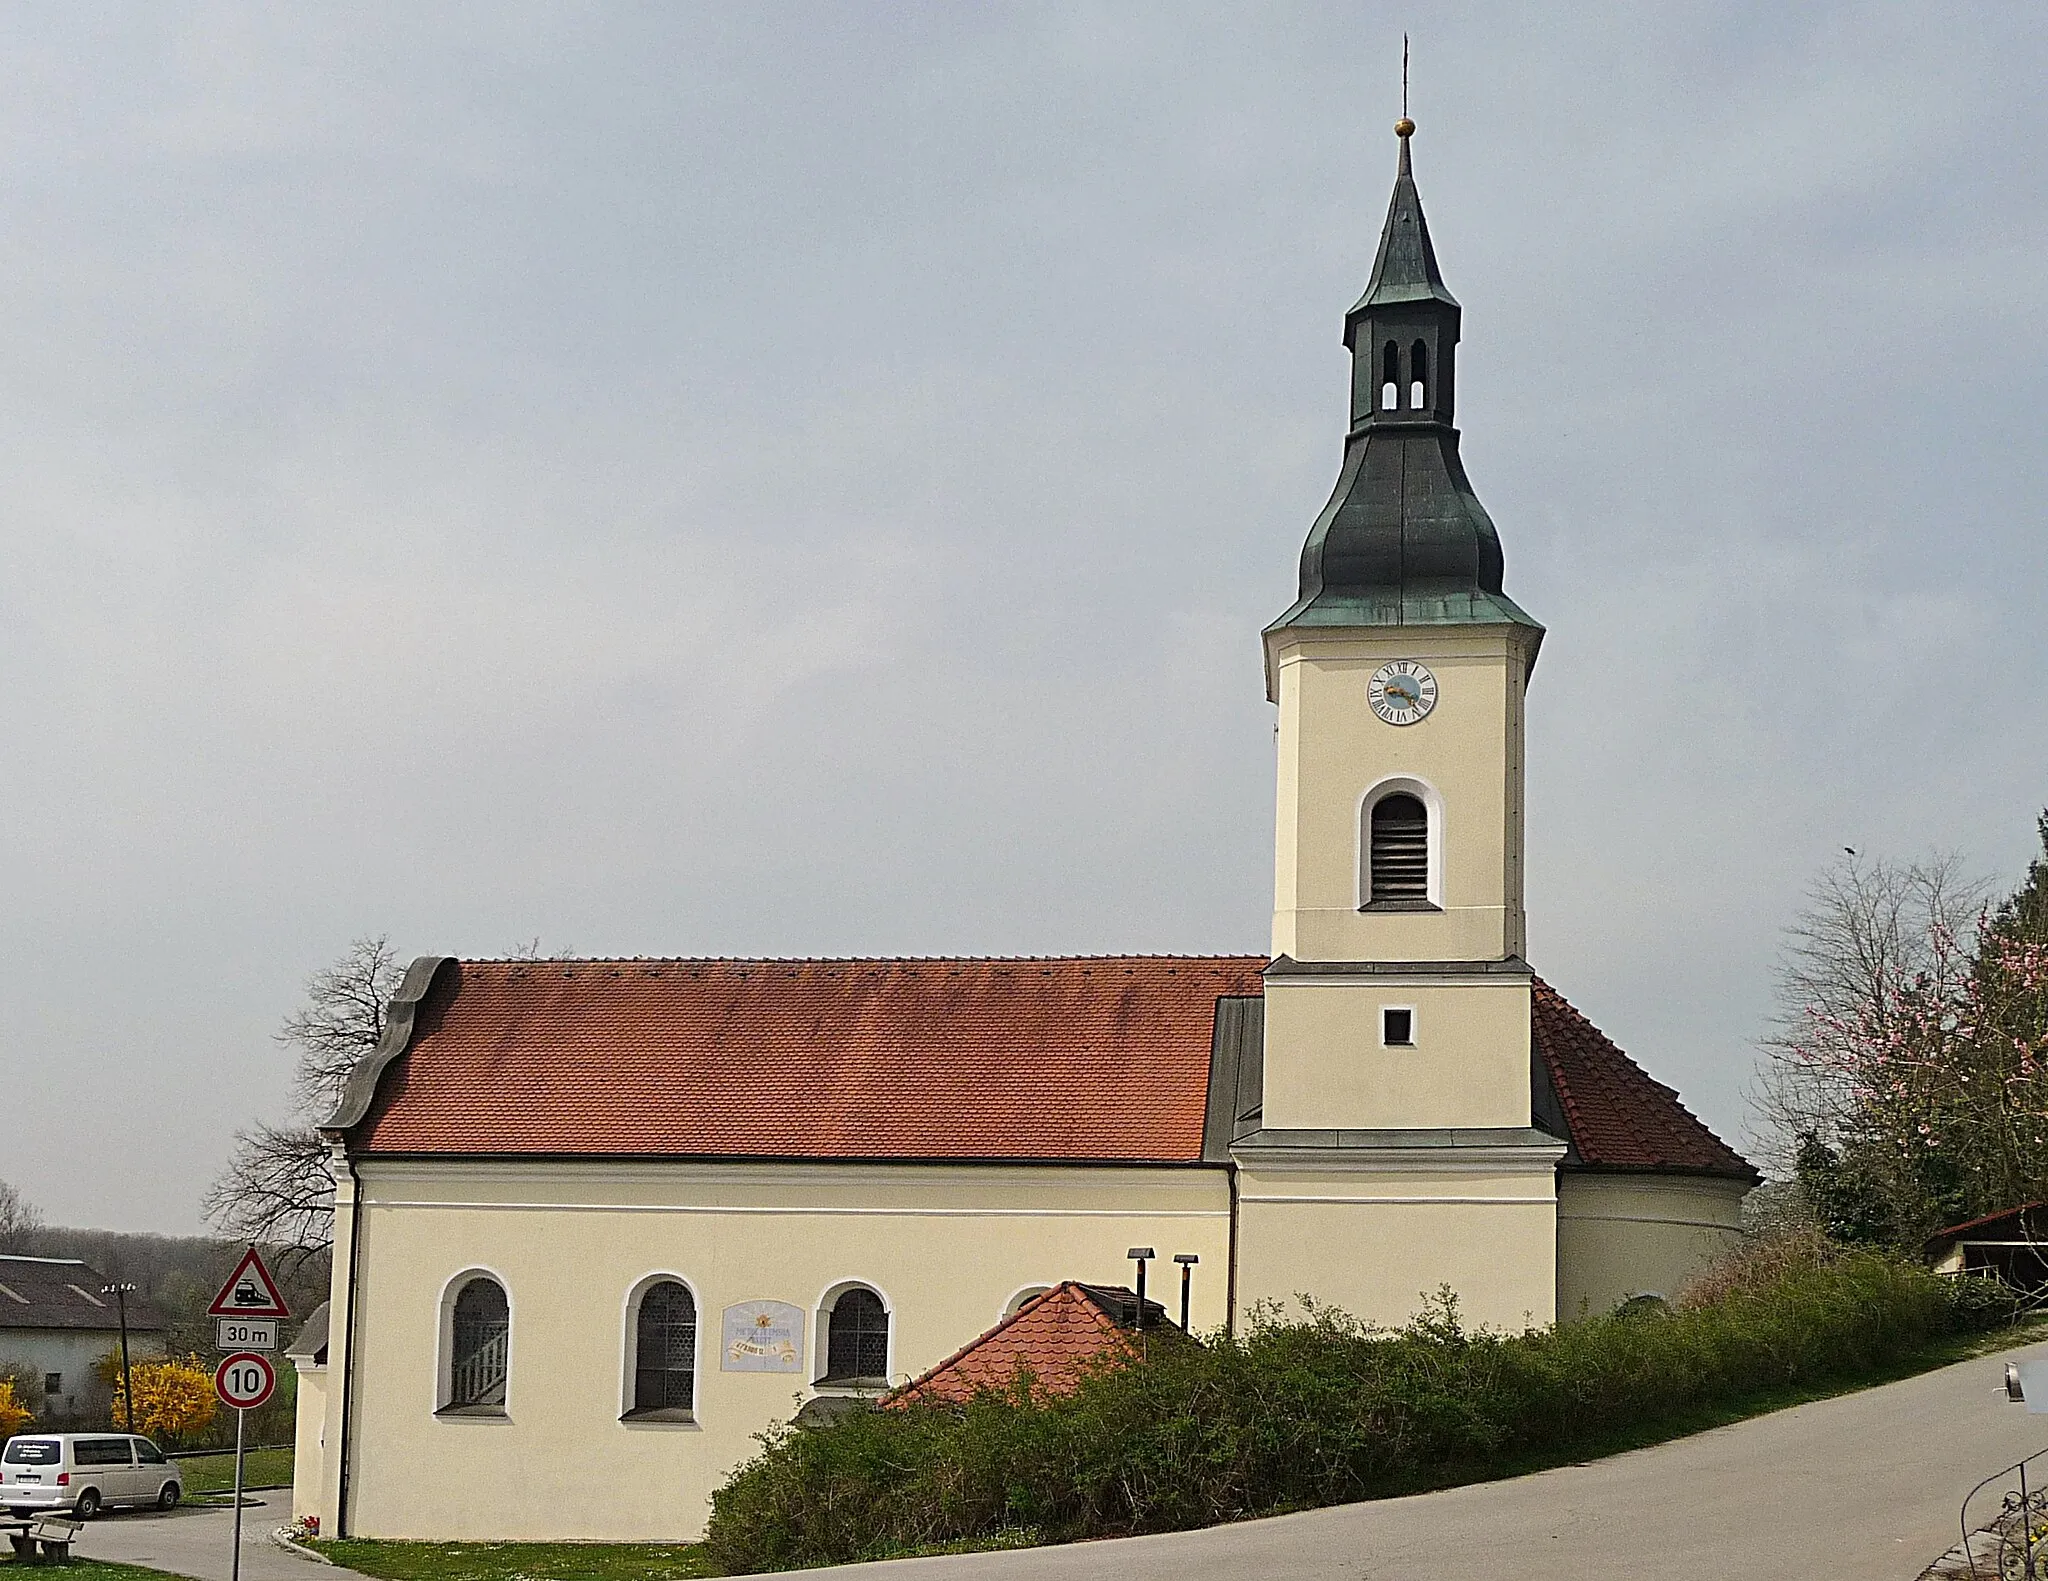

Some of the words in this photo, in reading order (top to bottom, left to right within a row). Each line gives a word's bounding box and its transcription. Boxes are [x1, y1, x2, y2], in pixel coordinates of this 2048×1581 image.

[1397, 662, 1408, 673] XII
[1411, 666, 1419, 675] I
[1418, 674, 1430, 684] II
[1422, 687, 1434, 695] III
[1397, 710, 1408, 722] VI
[227, 1327, 248, 1341] 30
[252, 1331, 267, 1342] m
[231, 1368, 259, 1393] 10
